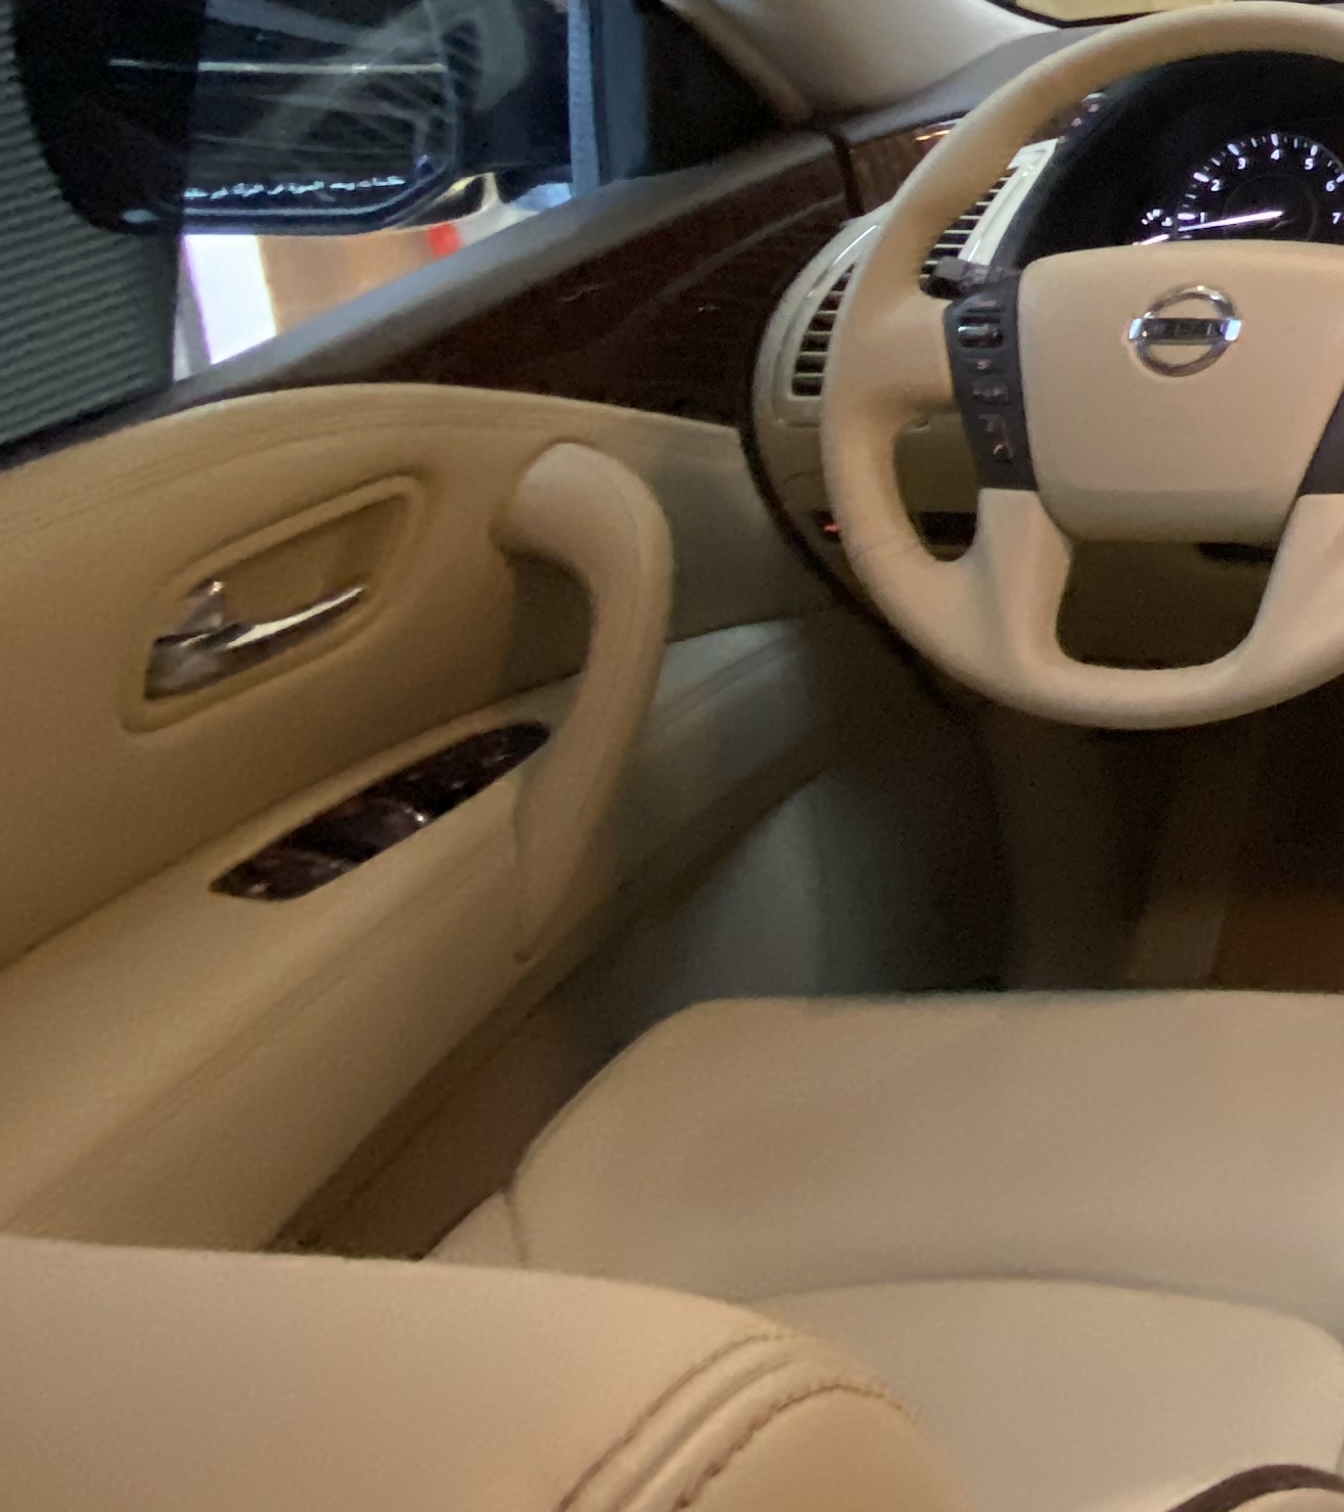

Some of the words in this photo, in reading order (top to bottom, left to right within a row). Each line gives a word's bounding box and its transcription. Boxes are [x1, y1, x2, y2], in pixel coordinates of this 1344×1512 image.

[1271, 149, 1280, 160] 4
[1238, 158, 1246, 170] 3
[1304, 158, 1314, 170] 5
[1211, 179, 1220, 191] 2
[1326, 180, 1335, 192] 6
[1332, 212, 1341, 224] 7
